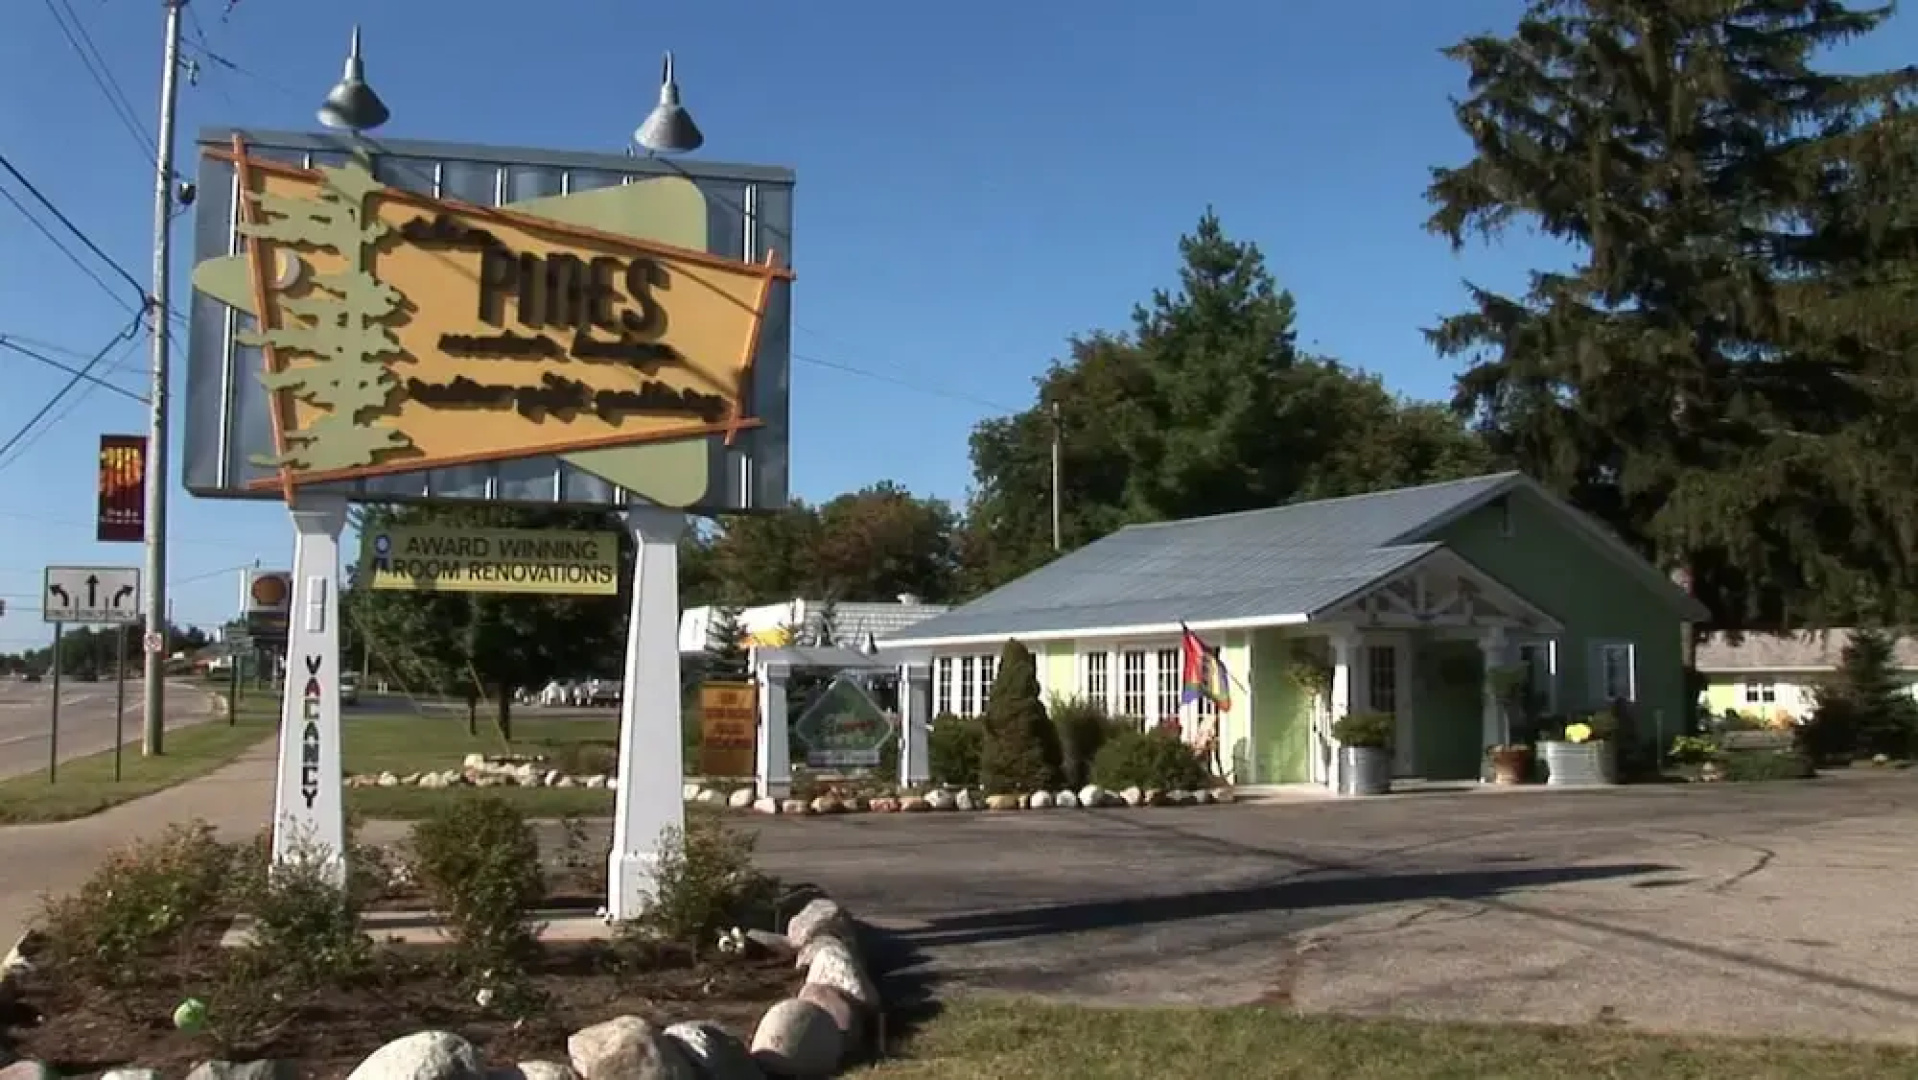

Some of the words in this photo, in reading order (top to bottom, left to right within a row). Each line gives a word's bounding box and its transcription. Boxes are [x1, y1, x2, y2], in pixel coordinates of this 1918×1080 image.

[479, 244, 670, 340] PINES
[392, 559, 461, 580] ROOM
[468, 560, 614, 584] RENOVATIONS
[406, 536, 490, 558] AWARD
[499, 537, 599, 560] WINNING
[302, 654, 322, 809] VACANCY
